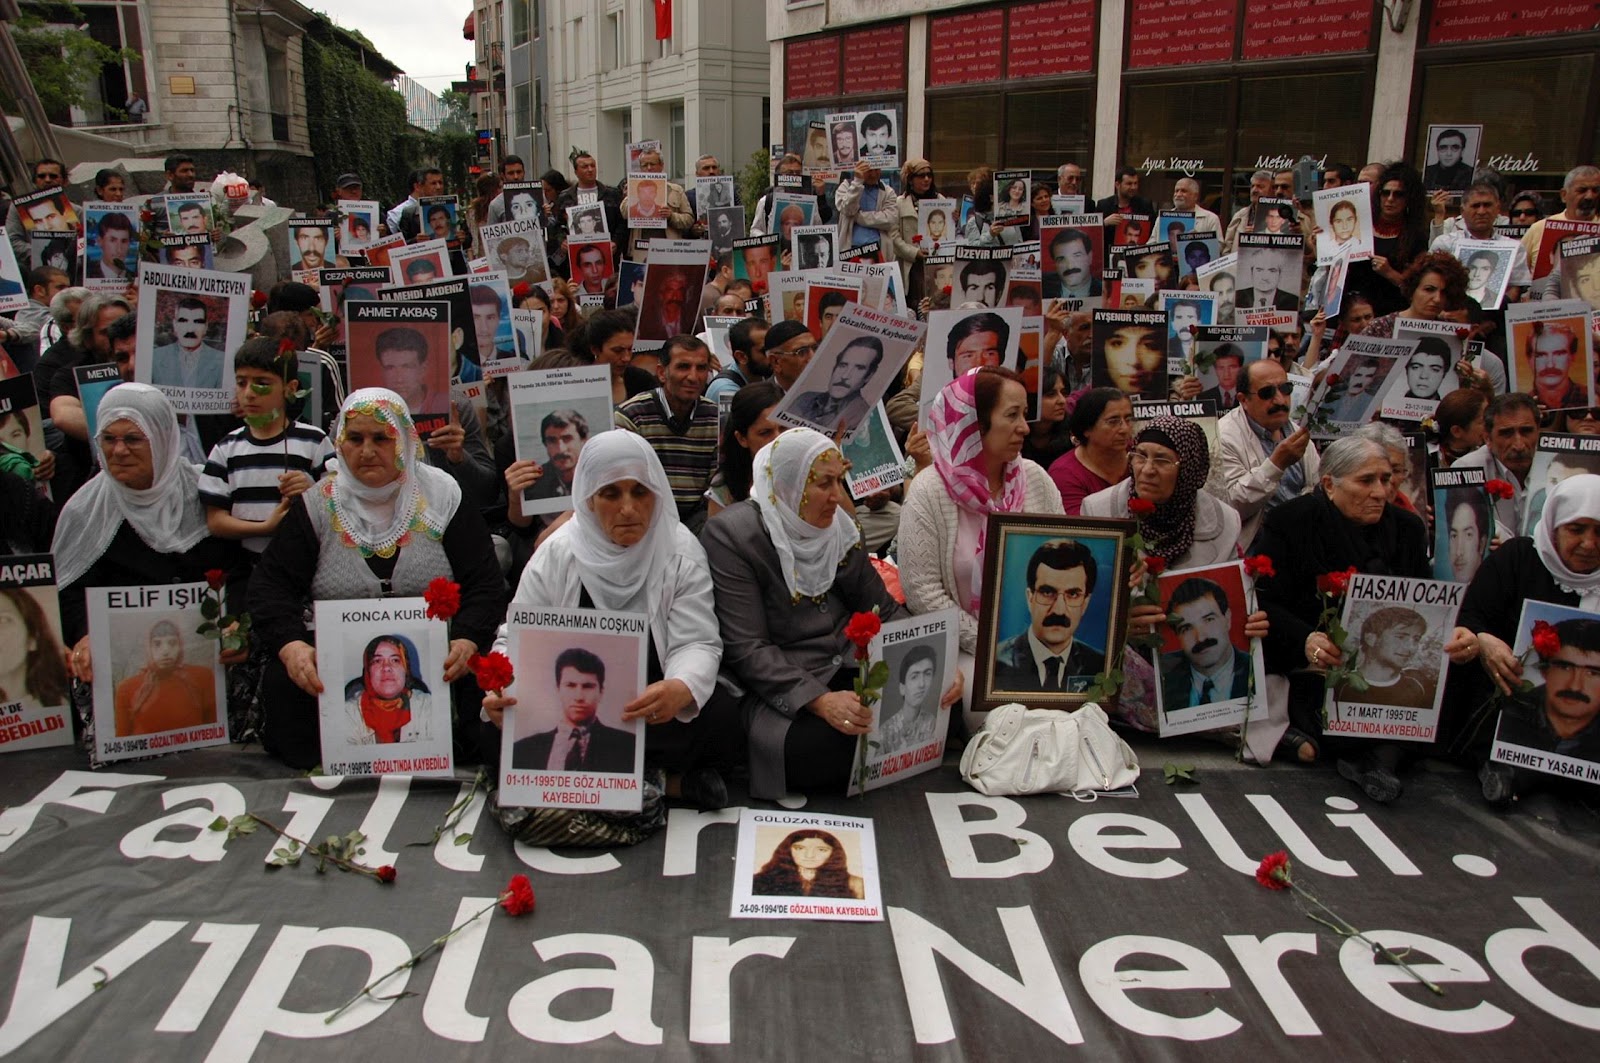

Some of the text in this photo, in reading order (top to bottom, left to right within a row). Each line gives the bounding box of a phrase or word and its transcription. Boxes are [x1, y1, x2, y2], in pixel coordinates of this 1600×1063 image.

[1442, 11, 1508, 26] Sabahattin Ali
[1521, 8, 1547, 19] Yusuf
[1141, 155, 1205, 177] Ayın Yazarı
[1254, 154, 1293, 171] Metin
[1486, 153, 1540, 174] Kitabı
[1318, 188, 1364, 201] HATİCE ŞİMŞEK
[1071, 214, 1099, 227] TAŞKAYA
[1545, 221, 1575, 231] KENAN
[482, 218, 540, 240] HASAN OCAK
[733, 238, 761, 248] MUSTAFA
[1271, 236, 1303, 246] YILMAZ
[992, 247, 1012, 259] KURT
[1562, 247, 1591, 258] YAMAN
[470, 272, 500, 283] ZEYREK
[841, 262, 885, 277] ELİF IŞIK
[142, 270, 247, 297] ABDULKERİM YURTSEVEN
[357, 306, 438, 321] AHMET AKBAŞ
[850, 307, 862, 316] 14
[862, 309, 889, 325] MAYIS
[1094, 311, 1132, 324] AYŞENUR
[839, 316, 920, 344] Gözaltında Kaybedildi
[1207, 325, 1256, 335] MEHMET EMİN
[1399, 320, 1441, 331] MAHMUT
[1219, 334, 1243, 342] ASLAN
[86, 365, 119, 380] METİN
[190, 388, 230, 400] 1995'DE
[1133, 403, 1204, 418] HASAN OCAK
[1434, 471, 1486, 487] MURAT YILDIZ
[0, 562, 52, 585] AÇAR
[107, 586, 160, 609] ELİF
[1351, 576, 1464, 606] HASAN OCAK
[341, 608, 433, 624] KONCA KURİ
[512, 611, 645, 634] ABDURRAHMAN COŞKUN
[882, 619, 947, 645] FERHAT TEPE
[1347, 705, 1418, 722] 21 MART 1995'DE
[1328, 718, 1435, 739] GÖZALTINDA KAYBEDİLDİ
[149, 734, 188, 750] GÖZALTINDA
[189, 725, 226, 744] KAYBEDİLDİ
[372, 758, 412, 774] GÖZALTINDA
[412, 754, 450, 771] KAYBEDİLDİ
[881, 750, 914, 777] GÖZALTINDA
[1495, 747, 1544, 769] MEHMET
[1546, 757, 1583, 778] YAŞAR
[506, 774, 637, 790] 01-11-1995'DE GÖZ ALTINDA
[542, 789, 601, 805] KAYBEDİLDİ
[753, 814, 865, 830] GÜLÜZAR SERİN
[925, 790, 1498, 880] Belli.
[739, 903, 879, 917] 24-09-1994'DE GÖZALTINDA KAYBEDİLDİ
